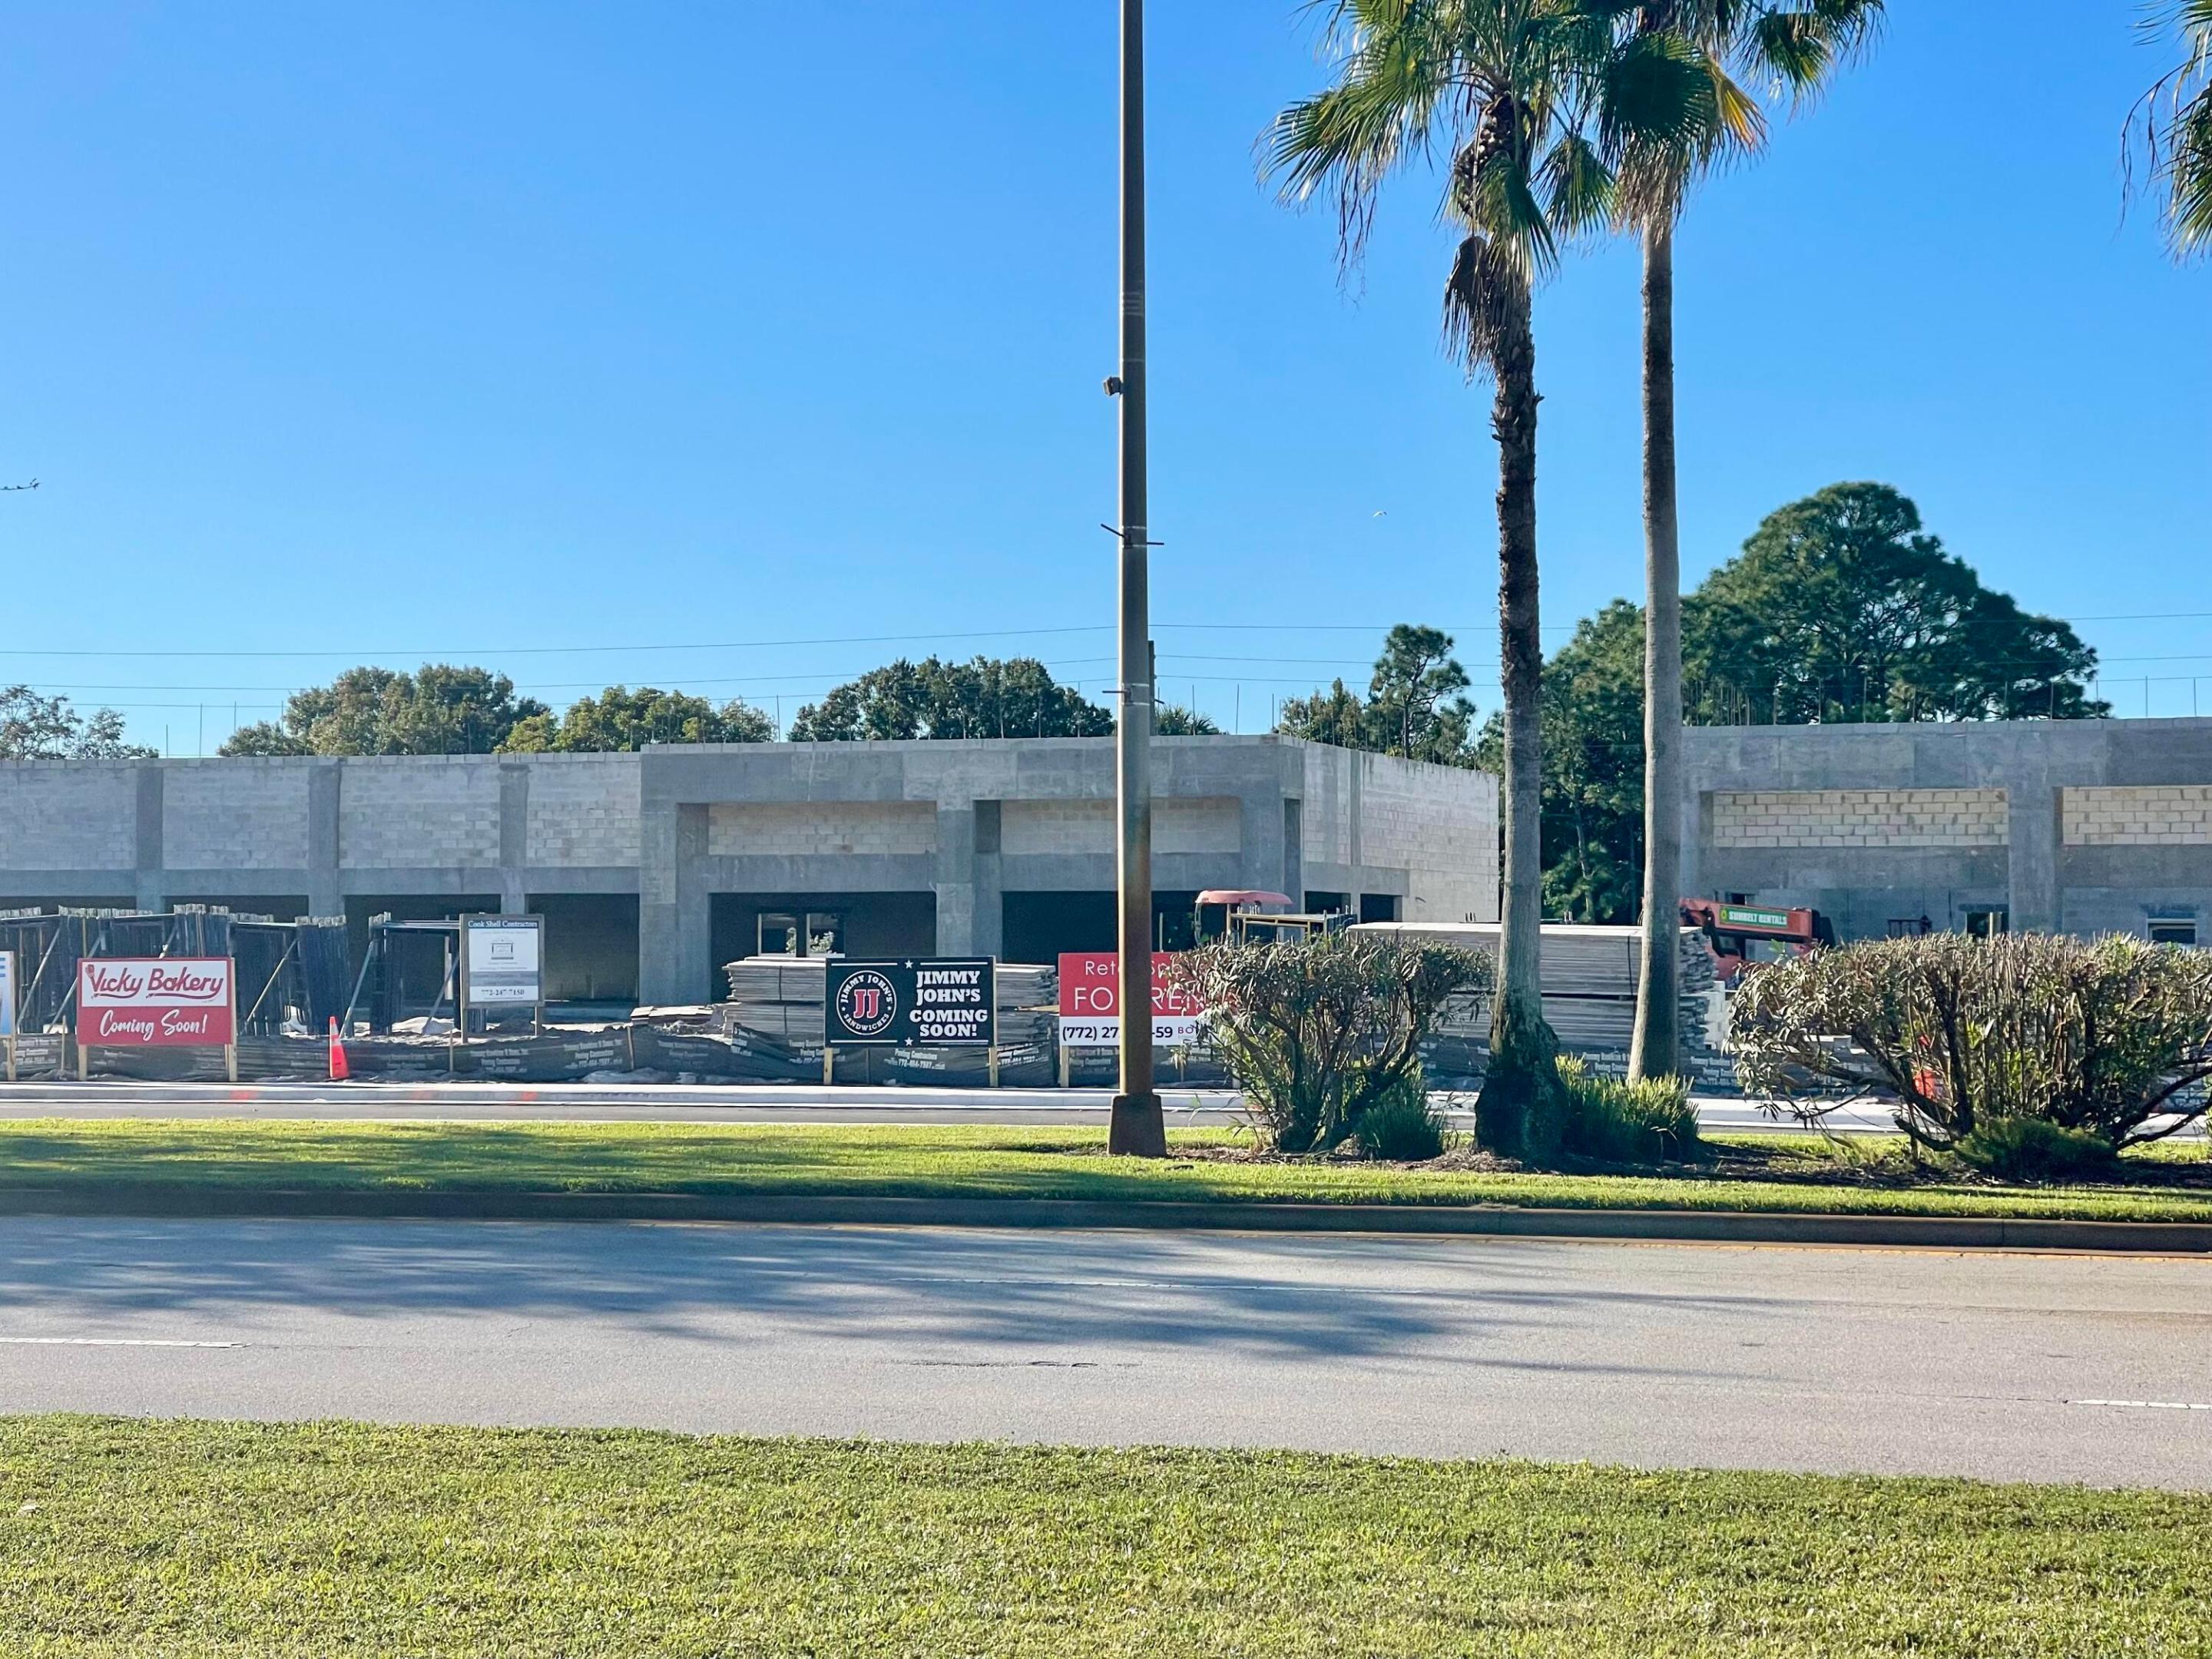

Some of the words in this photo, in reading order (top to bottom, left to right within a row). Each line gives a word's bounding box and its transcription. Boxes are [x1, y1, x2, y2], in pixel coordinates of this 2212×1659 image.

[87, 966, 144, 998] Vicky
[146, 966, 224, 999] Bakery
[917, 971, 980, 988] JIMMY
[840, 975, 864, 1003] JIMMY
[867, 975, 892, 1003] JOHN'S
[916, 988, 981, 1006] JOHN'S
[853, 989, 879, 1018] JJ
[843, 1014, 889, 1031] SANDWICHES
[909, 1009, 988, 1022] COMING
[100, 1009, 154, 1041] Coming
[161, 1009, 208, 1036] Soon!
[920, 1024, 977, 1037] SOON!
[1062, 1026, 1098, 1041] (772)
